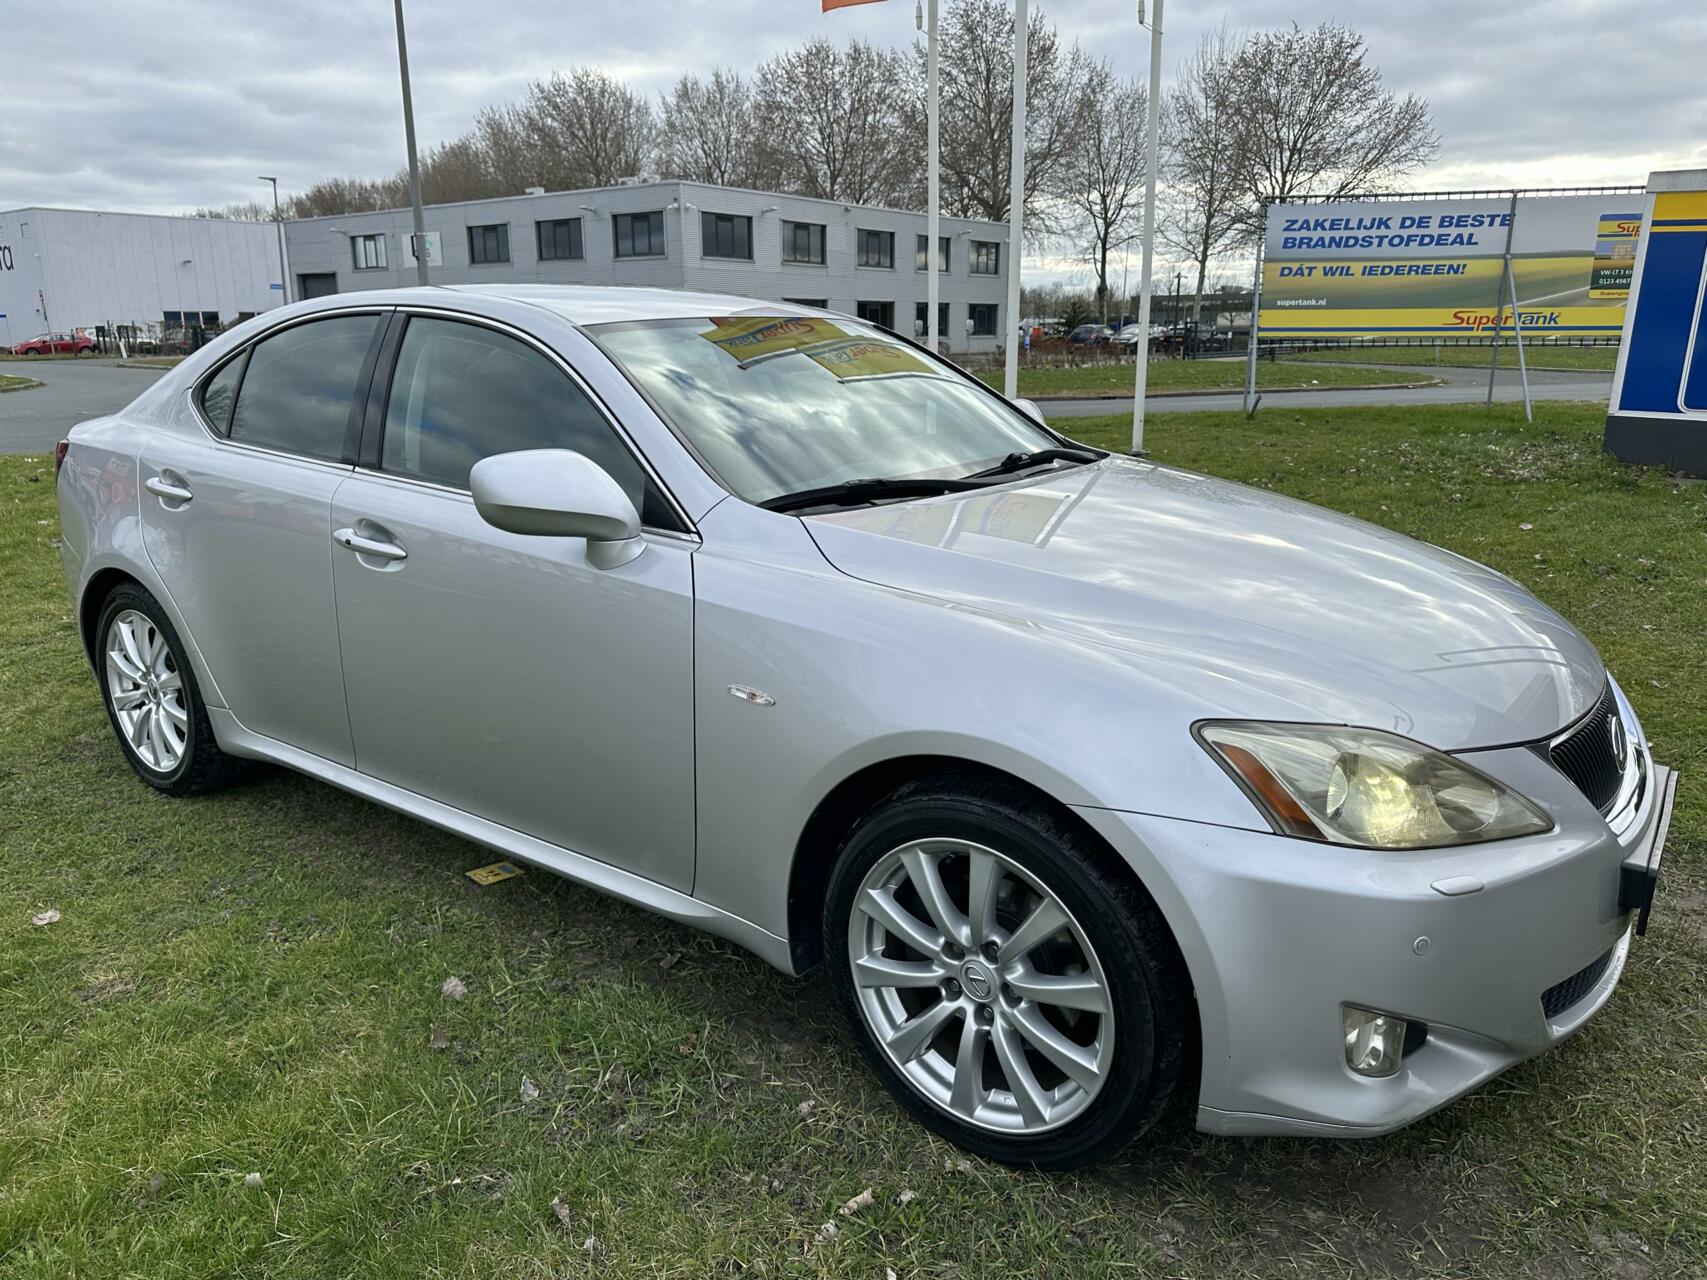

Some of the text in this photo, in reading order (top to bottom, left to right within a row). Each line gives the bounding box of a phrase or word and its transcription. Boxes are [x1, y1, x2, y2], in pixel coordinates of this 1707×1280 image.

[1282, 213, 1513, 232] ZAKELIJK DE BESTE
[1281, 233, 1479, 250] BRANDSTOFDEAL
[1279, 263, 1467, 277] DÁT WIL IEDEREEN!
